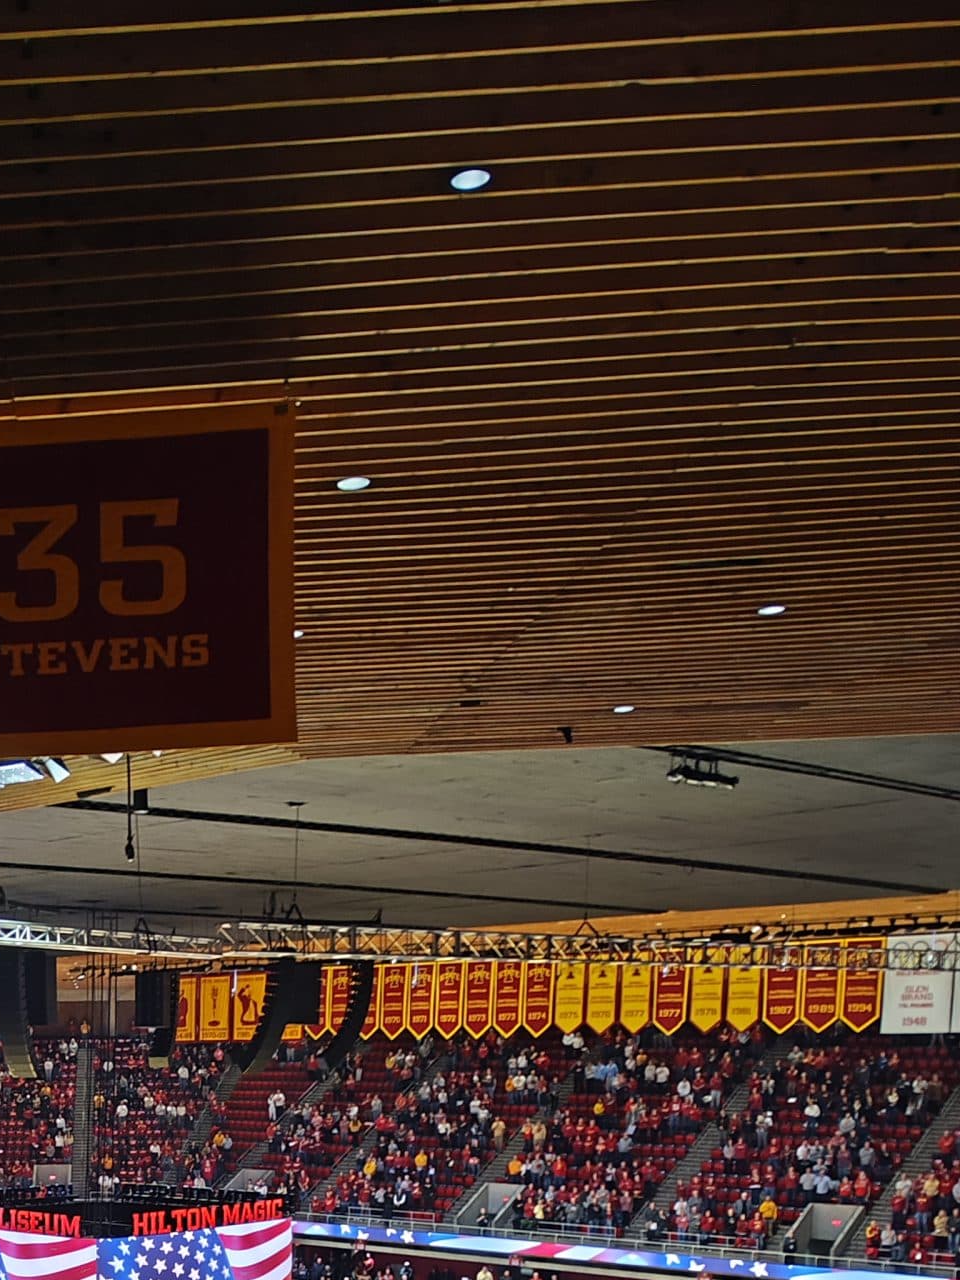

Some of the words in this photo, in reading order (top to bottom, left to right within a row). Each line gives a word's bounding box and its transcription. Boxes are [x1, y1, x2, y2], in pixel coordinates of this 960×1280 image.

[658, 1008, 680, 1018] 1977
[808, 1004, 835, 1013] 1989
[847, 1003, 873, 1013] 1994
[131, 1204, 216, 1236] HILTON
[223, 1198, 284, 1225] MAGIC
